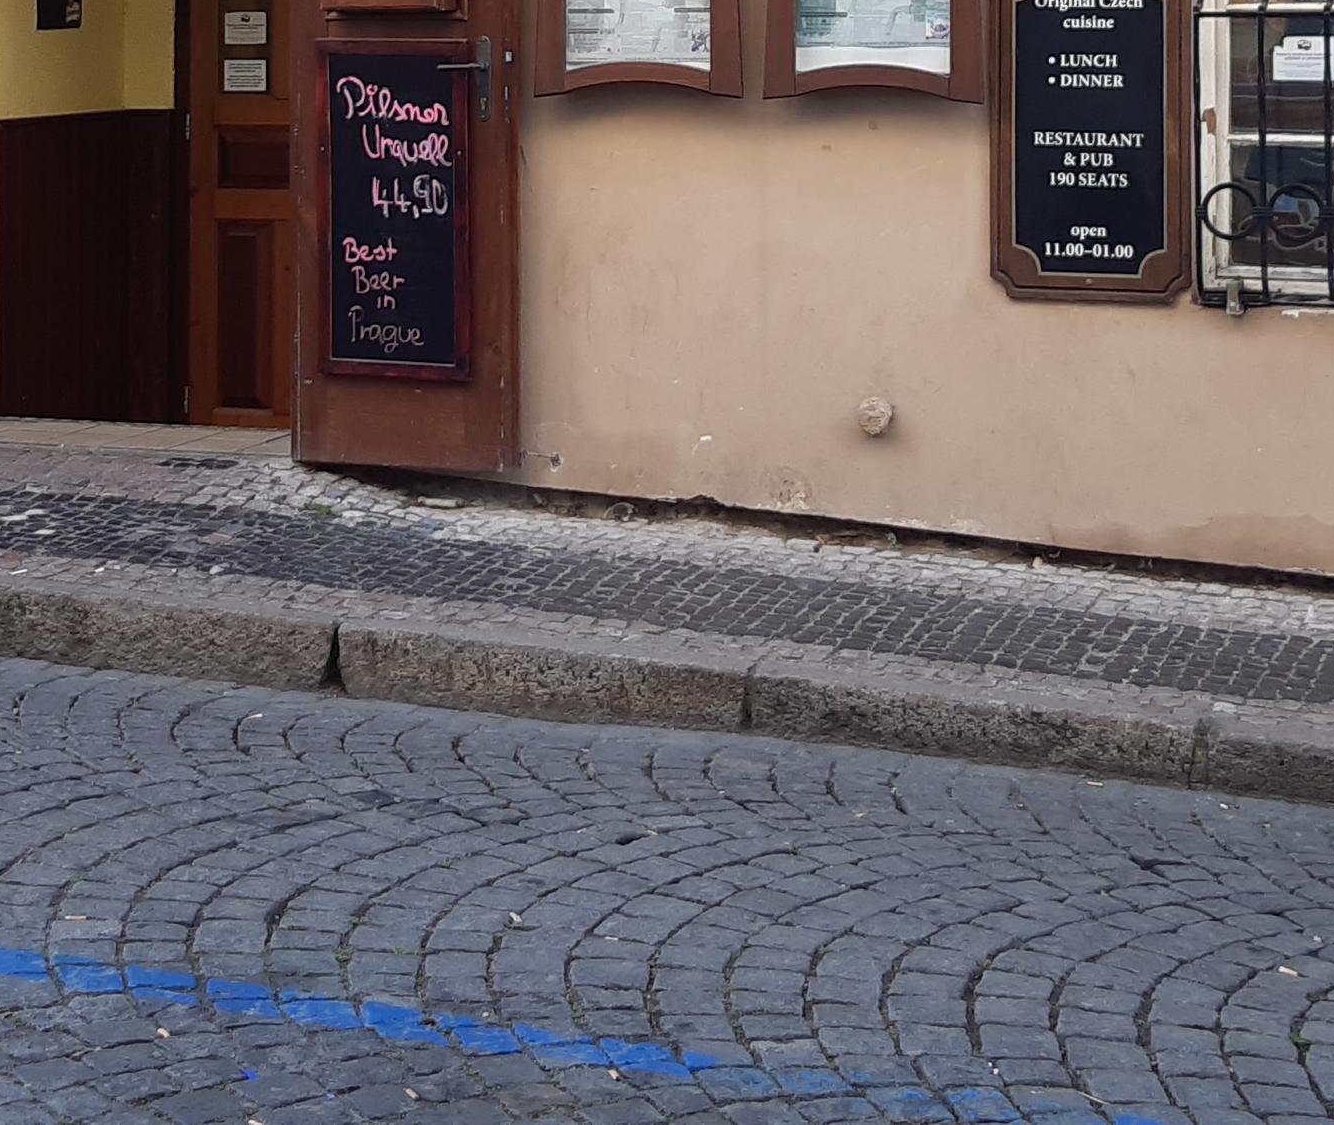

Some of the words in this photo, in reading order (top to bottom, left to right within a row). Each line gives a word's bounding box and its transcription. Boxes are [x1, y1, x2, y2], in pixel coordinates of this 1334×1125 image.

[1063, 15, 1114, 28] cuisine
[1060, 54, 1117, 67] LUNCH
[1060, 74, 1124, 87] DINNER
[362, 124, 452, 167] Urquell
[1033, 131, 1144, 147] RESTAURANT
[1063, 152, 1076, 166] &
[1080, 153, 1113, 166] PUB
[1049, 172, 1075, 186] 190
[1078, 173, 1128, 187] SEATS
[1070, 226, 1107, 239] open
[342, 236, 398, 263] Best
[351, 265, 405, 294] Beer
[376, 295, 395, 310] in
[348, 305, 424, 354] Prague
